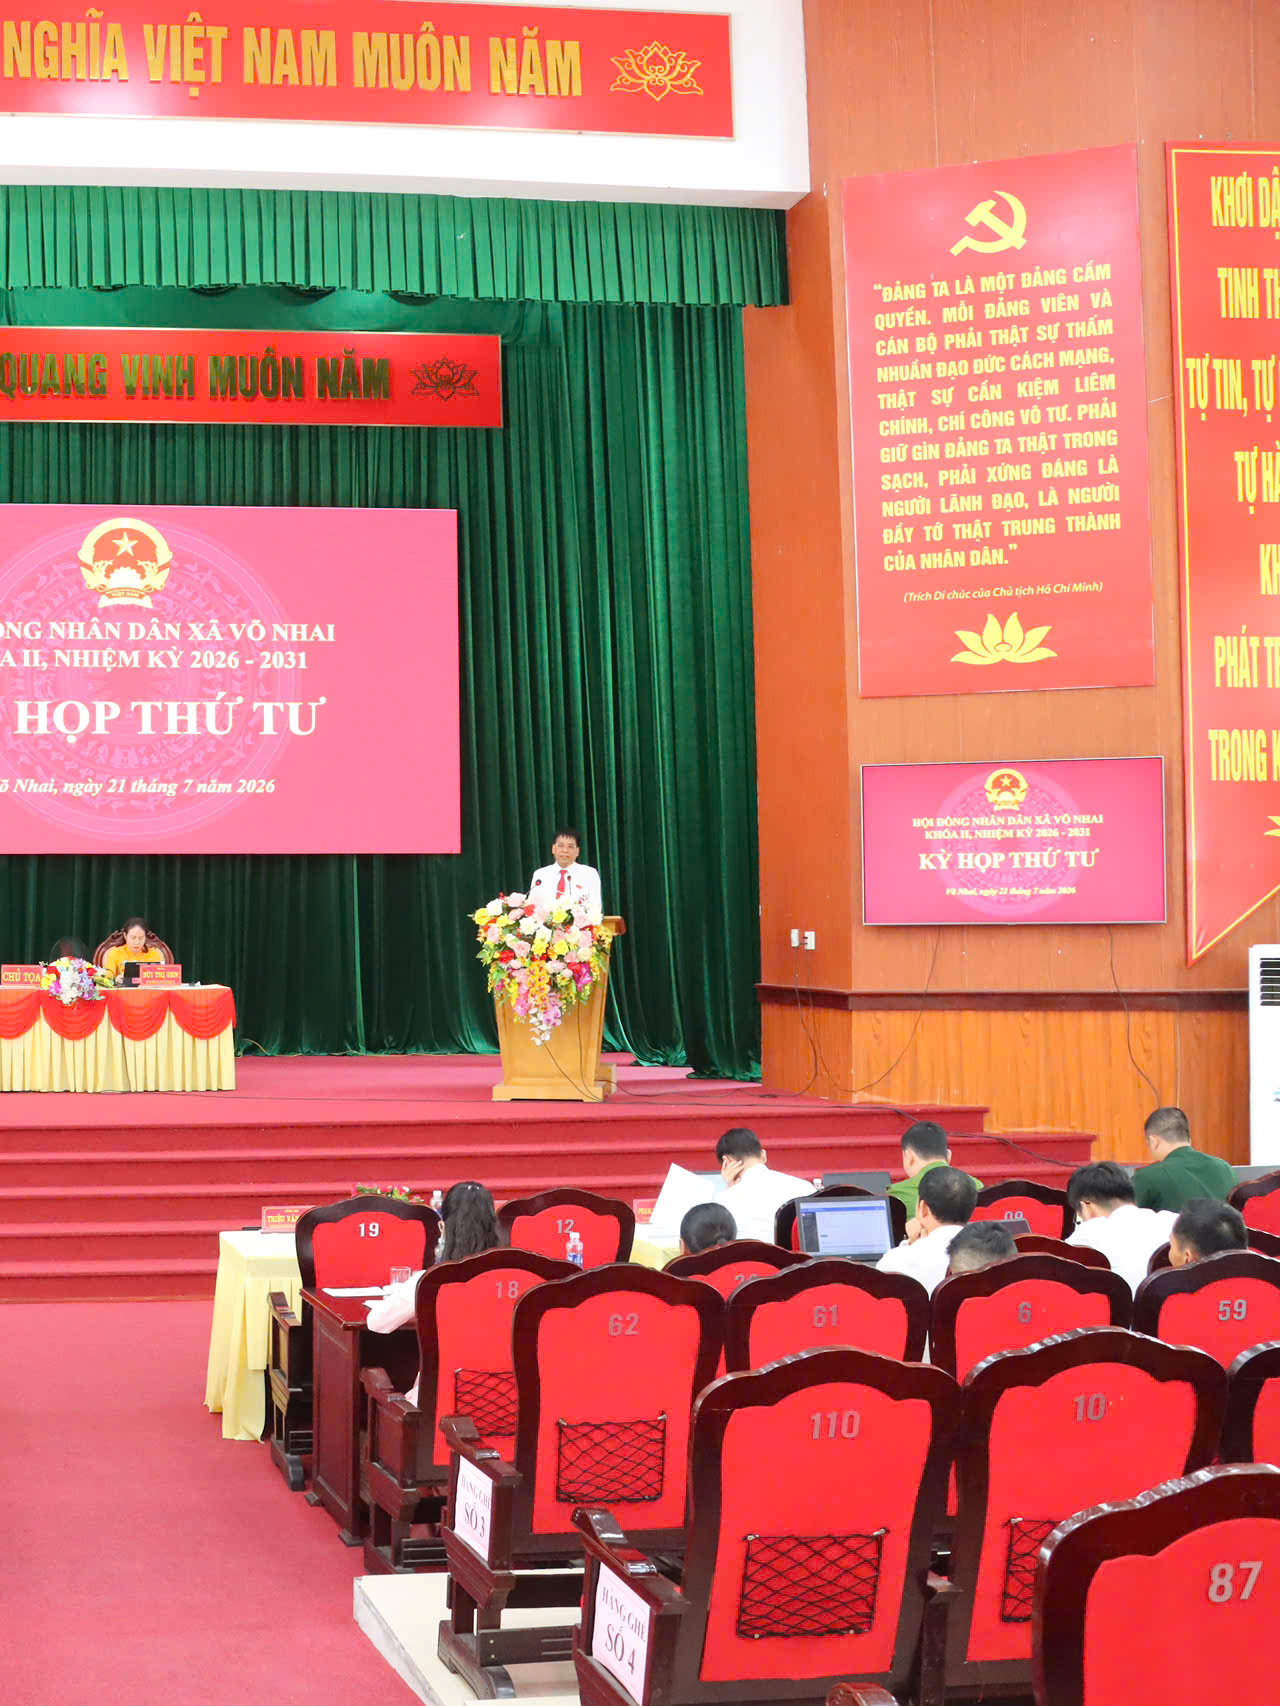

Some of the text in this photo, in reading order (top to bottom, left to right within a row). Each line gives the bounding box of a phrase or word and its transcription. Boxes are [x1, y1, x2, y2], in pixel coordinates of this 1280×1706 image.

[4, 8, 128, 82] NGHĨA
[143, 12, 228, 98] VIỆT
[243, 28, 337, 88] NAM
[352, 20, 472, 93] MUÔN
[490, 26, 582, 97] NĂM
[931, 281, 949, 297] TA
[955, 275, 975, 295] LÀ
[980, 272, 1016, 294] MỘT
[1021, 266, 1066, 288] ĐẢNG
[1217, 267, 1260, 319] TINH
[984, 297, 1030, 319] ĐẢNG
[1041, 293, 1079, 313] VIÊN
[1090, 288, 1112, 308] VÀ
[876, 314, 1113, 356] CÁN BỘ PHẢI THẬT SỰ THẤM
[122, 355, 195, 398] VINH
[209, 347, 303, 399] MUÔN
[317, 347, 391, 400] NĂM
[936, 359, 968, 380] ĐẠO
[973, 354, 1006, 374] ĐỨC
[1010, 351, 1054, 371] CÁCH
[1059, 347, 1114, 368] MẠNG,
[877, 389, 916, 411] THẬT
[931, 387, 954, 408] SỰ
[1017, 377, 1059, 400] KIỆM
[1075, 372, 1115, 393] LIÊM
[1186, 353, 1276, 425] TỰ TIN, TỰ
[879, 397, 1116, 436] CHÍNH, CHÍ CÔNG VÔ TƯ. PHẢI
[880, 430, 1118, 463] GIỮ GÌN ĐẢNG TA THẬT TRONG
[881, 454, 1119, 493] SẠCH, PHẢI XỨNG ĐÁNG LÀ
[1234, 446, 1258, 514] TỰ
[882, 482, 1120, 517] NGƯỜI LÃNH ĐẠO, LÀ NGƯỜI
[923, 522, 944, 542] TỚ
[952, 519, 992, 542] THẬT
[1001, 517, 1056, 537] TRUNG
[1065, 512, 1121, 533] THÀNH
[883, 550, 916, 571] CỦA
[920, 549, 965, 569] NHÂN
[947, 588, 970, 600] chúc
[972, 587, 991, 599] của
[993, 585, 1014, 598] Chủ
[1015, 585, 1034, 598] tịch
[1036, 583, 1051, 595] Hồ
[1053, 582, 1070, 594] Chí
[1072, 581, 1103, 593] Minh)
[48, 618, 123, 641] NHÂN
[129, 619, 184, 642] DÂN
[188, 619, 224, 642] XÃ
[229, 620, 266, 643] VÕ
[272, 623, 336, 642] NHAI
[22, 649, 48, 672] II,
[54, 647, 141, 673] NHIỆM
[147, 645, 185, 669] KỲ
[190, 650, 240, 670] 2026
[260, 651, 308, 670] 2031
[1214, 624, 1260, 688] PHÁT
[14, 700, 119, 744] HỌP
[130, 690, 243, 736] THỨ
[252, 696, 327, 736] TƯ
[1208, 729, 1267, 782] TRONG
[13, 778, 58, 795] Nhai,
[63, 779, 102, 796] ngày
[107, 779, 124, 793] 21
[131, 778, 178, 796] tháng
[183, 779, 192, 793] 7
[196, 778, 232, 793] năm
[236, 779, 276, 793] 2026
[919, 847, 1100, 874] KỲ HỌP THỨ TƯ
[358, 1223, 380, 1238] 19
[556, 1219, 574, 1234] 12
[496, 1281, 519, 1299] 18
[608, 1314, 640, 1337] 62
[813, 1305, 839, 1328] 61
[1019, 1302, 1032, 1323] 6
[1218, 1299, 1248, 1321] 59
[1074, 1394, 1106, 1422] 10
[810, 1410, 861, 1441] 110
[479, 1516, 485, 1538] 3
[1208, 1560, 1263, 1603] 87
[605, 1623, 636, 1675] SỐ 4
